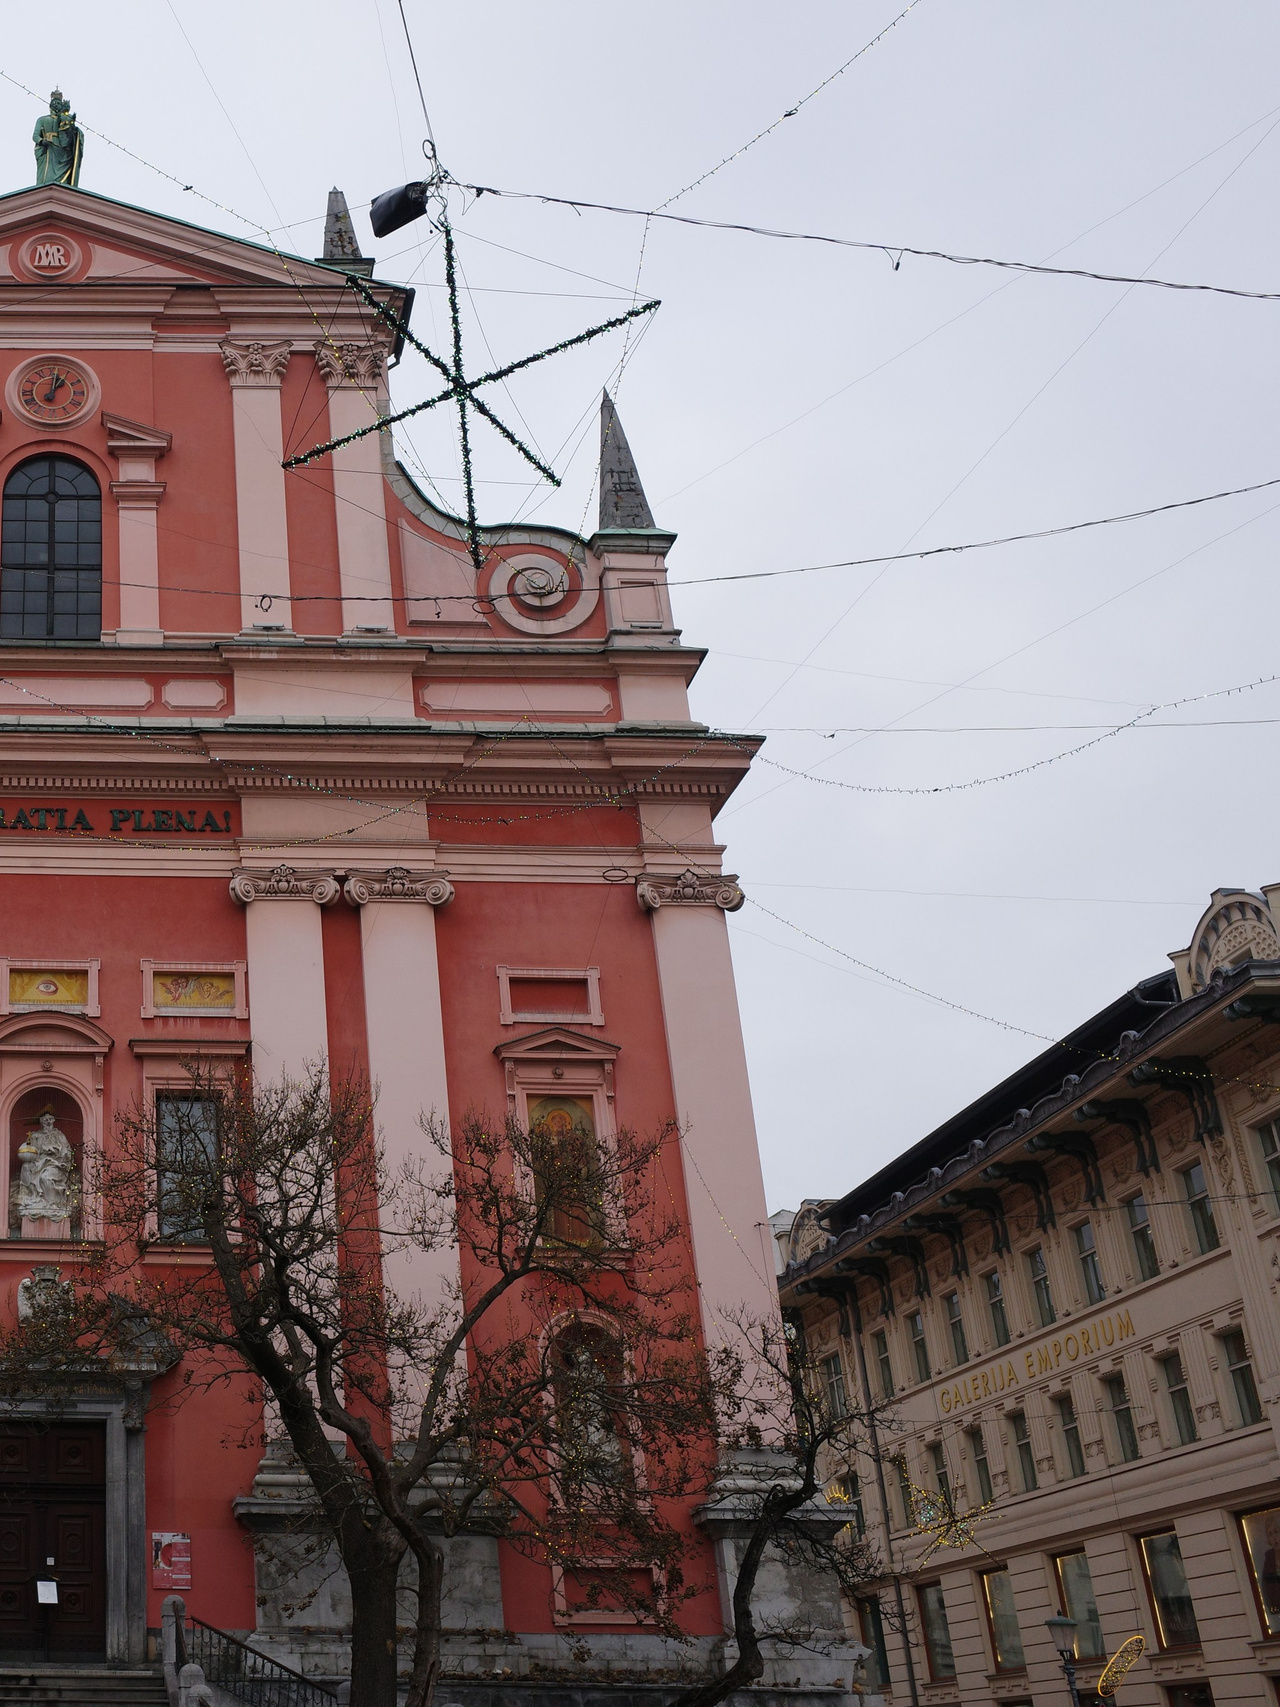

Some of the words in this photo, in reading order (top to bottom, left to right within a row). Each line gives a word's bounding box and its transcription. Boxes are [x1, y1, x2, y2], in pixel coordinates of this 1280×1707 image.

[109, 808, 232, 833] PLENA!
[939, 1360, 1019, 1413] GALERIJA
[1023, 1308, 1136, 1379] EMPORIUM
